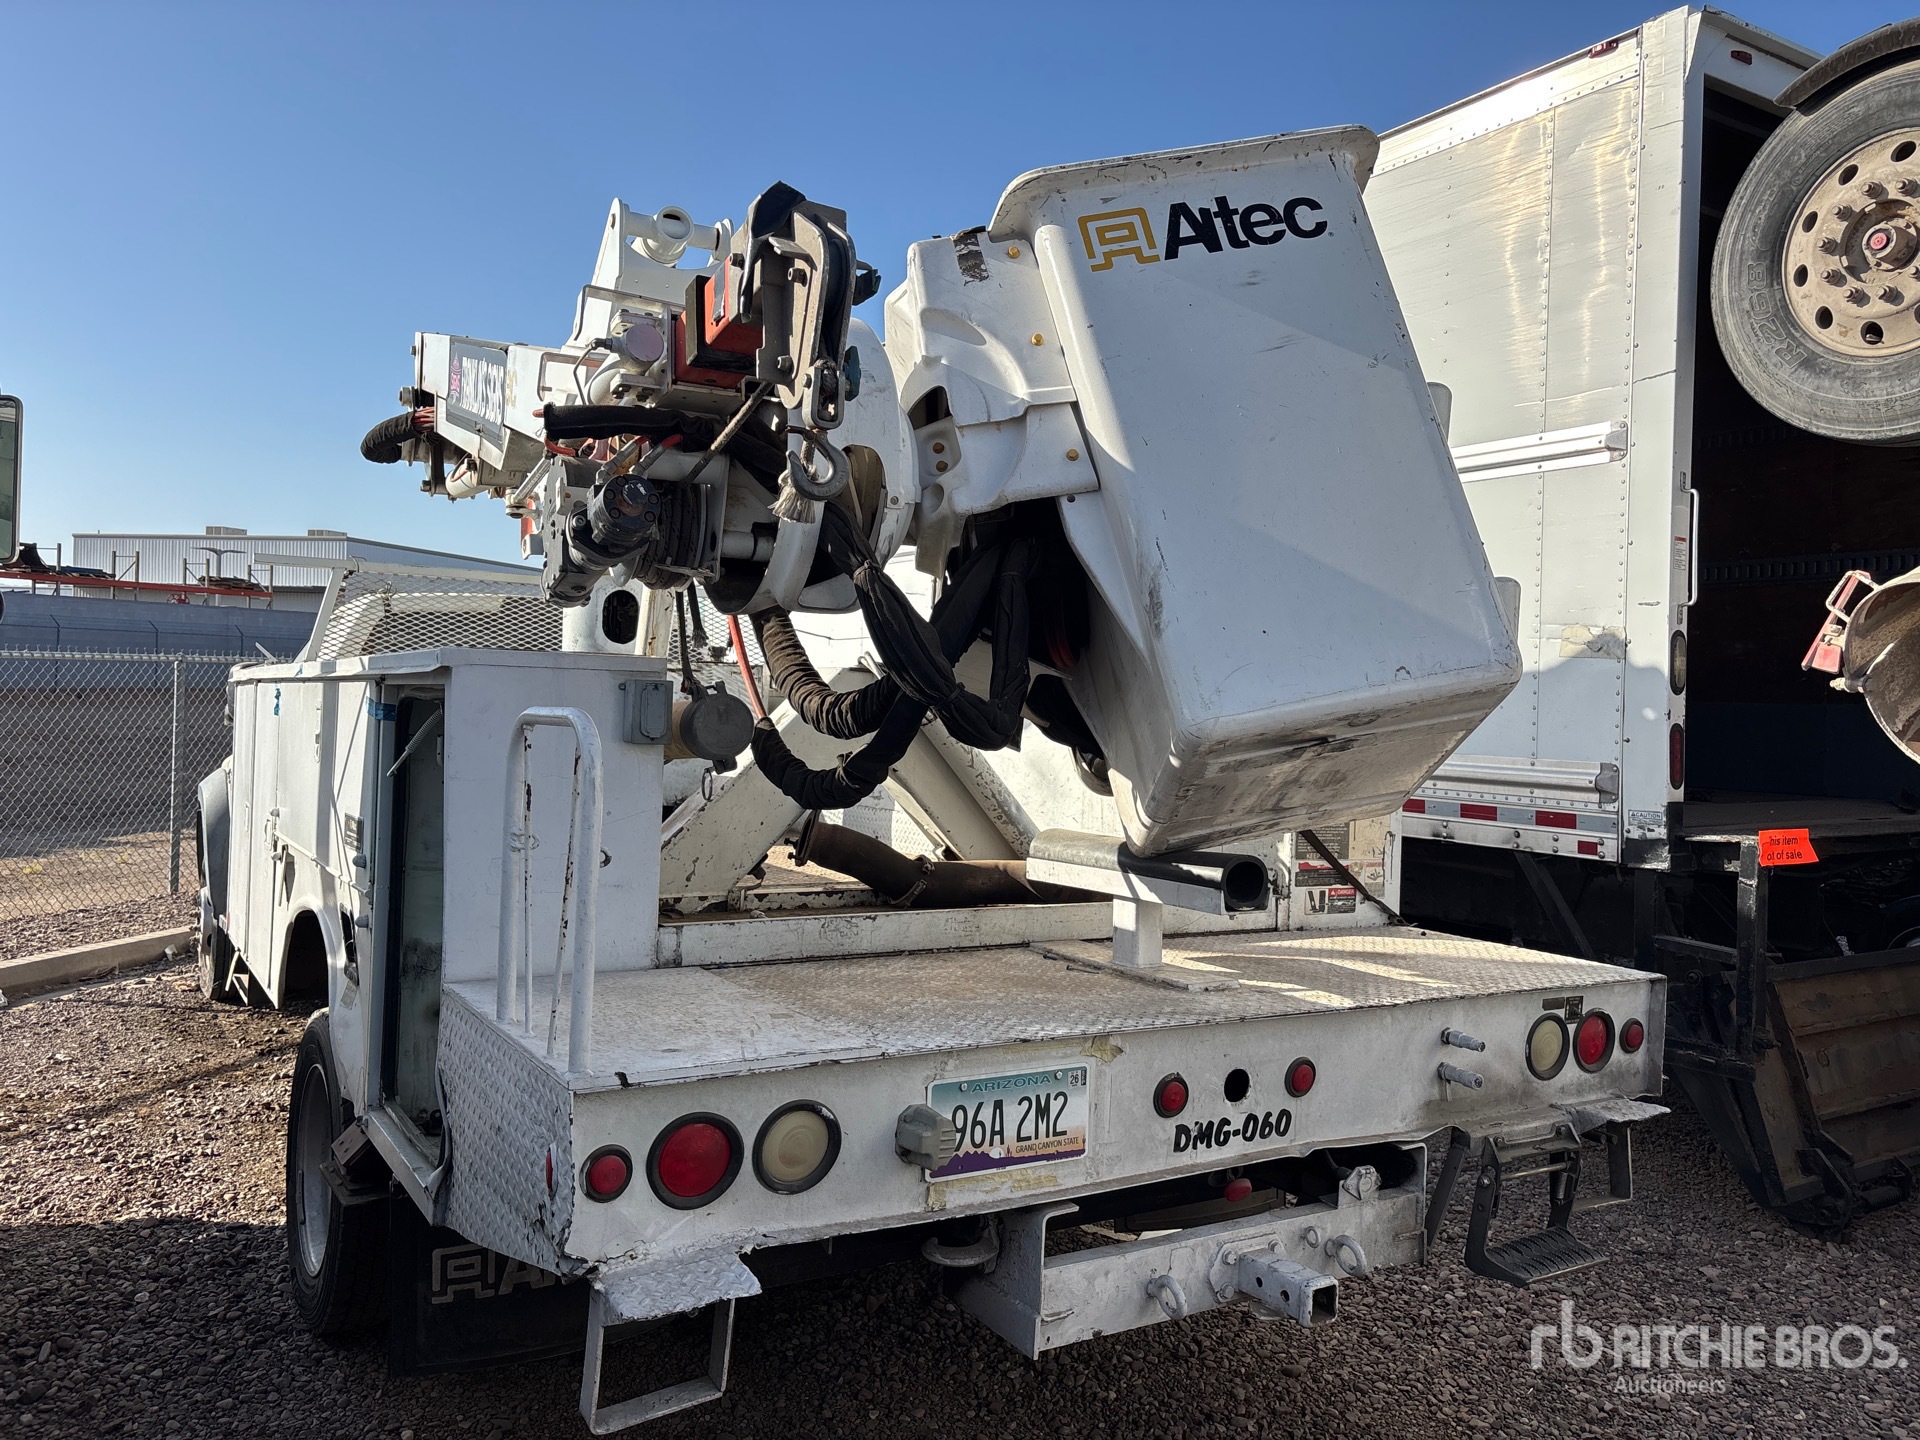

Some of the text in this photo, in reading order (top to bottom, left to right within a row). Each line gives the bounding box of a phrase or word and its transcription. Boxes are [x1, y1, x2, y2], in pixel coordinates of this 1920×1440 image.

[1164, 195, 1329, 260] Altec
[1747, 262, 1808, 369] R268
[1782, 835, 1799, 846] item
[1776, 849, 1784, 860] of
[1785, 849, 1803, 860] sale
[971, 1075, 1052, 1093] ARIZONA
[1069, 1074, 1080, 1085] 26
[951, 1090, 1069, 1153] 96A 2M2
[1173, 1108, 1292, 1153] DMG-060
[1015, 1136, 1080, 1154] GRAND CANYON STATE
